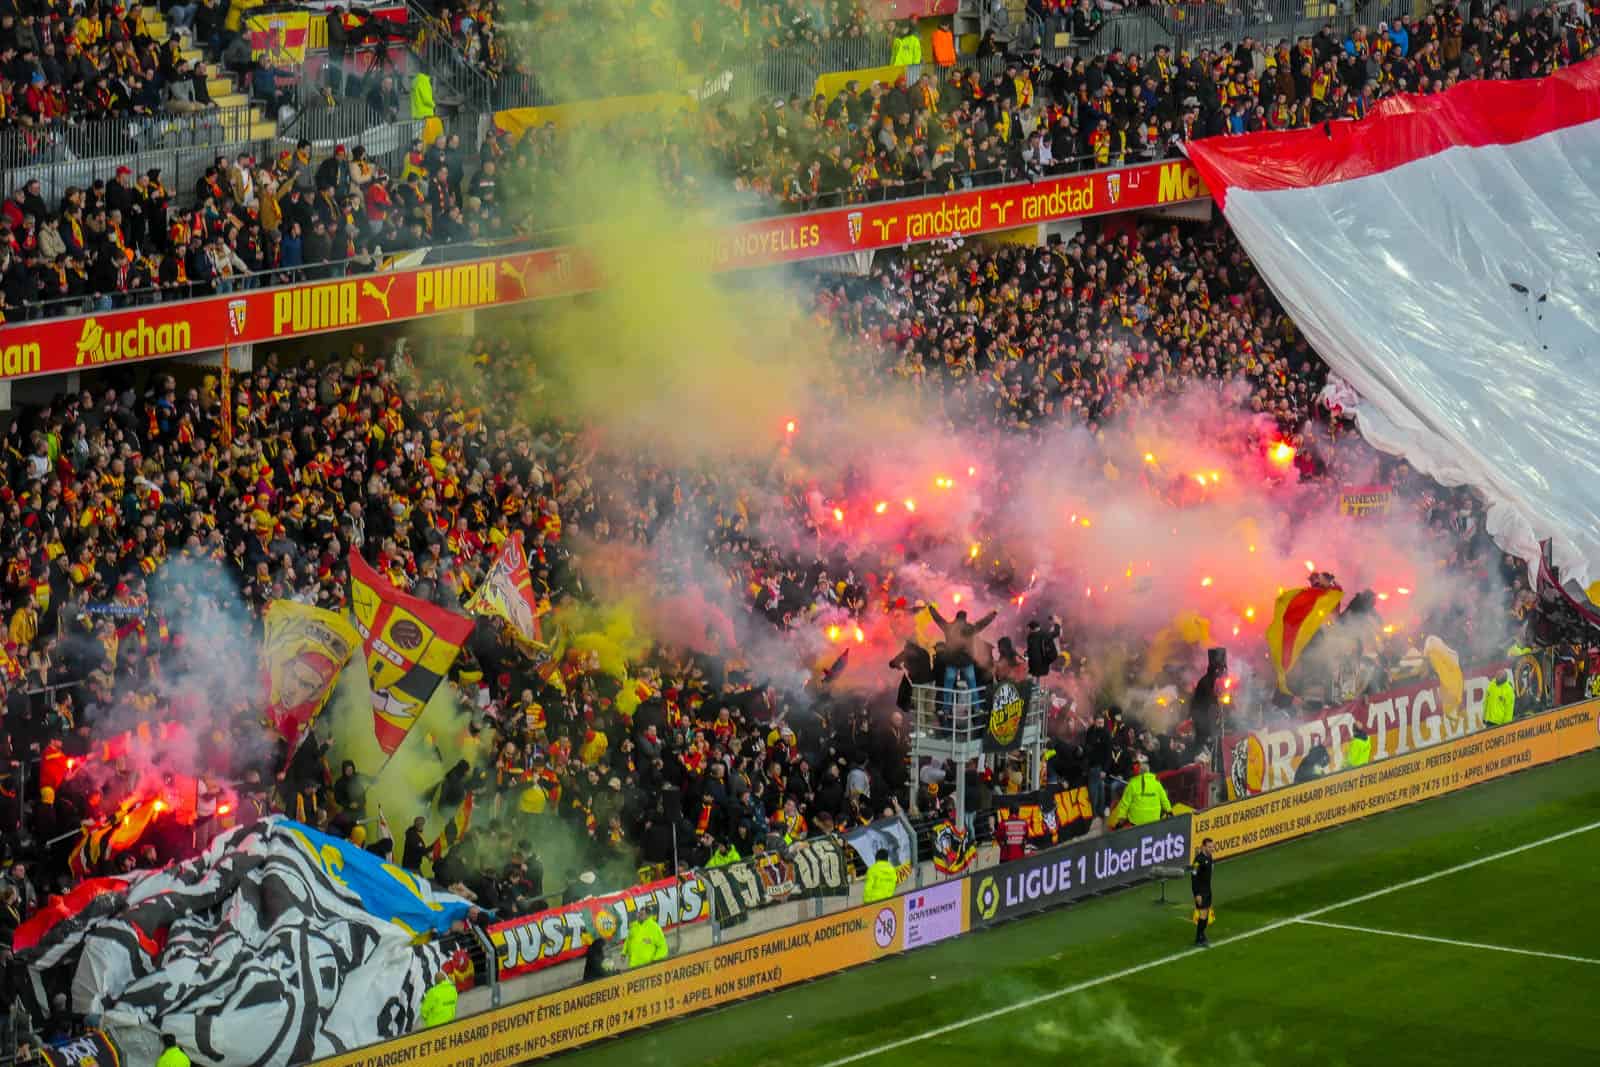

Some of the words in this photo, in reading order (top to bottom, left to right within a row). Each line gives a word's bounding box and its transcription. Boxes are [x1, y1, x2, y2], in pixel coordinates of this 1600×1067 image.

[906, 196, 983, 238] randstad
[1022, 177, 1095, 220] randstad
[733, 223, 820, 258] NOYELLES
[273, 281, 359, 335] PUMA
[415, 262, 497, 313] PUMA
[0, 341, 41, 375] an
[75, 317, 191, 366] Auchan
[1195, 818, 1210, 834] LES
[1211, 813, 1231, 829] JEUX
[1233, 805, 1271, 825] D'ARGENT
[1271, 802, 1281, 814] ET
[1282, 798, 1292, 810] DE
[1292, 790, 1323, 807] HASARD
[1325, 780, 1358, 798] PEUVENT
[1379, 760, 1421, 785] DANGEREUX
[1425, 753, 1451, 770] PERTES
[1242, 830, 1258, 845] NOS
[1259, 820, 1295, 840] CONSEILS
[1297, 815, 1311, 829] SUR
[1464, 765, 1484, 780] APPEL
[1485, 760, 1500, 775] NON
[709, 862, 761, 916] 19
[795, 839, 841, 889] 06
[1006, 859, 1072, 906] LIGUE
[1077, 855, 1086, 885] 1
[1095, 847, 1138, 879] Uber
[1141, 833, 1185, 867] Eats
[908, 901, 957, 921] GOUVERNEMENT
[503, 911, 588, 969] JUST
[367, 1044, 417, 1067] D'ARGENT
[420, 1040, 433, 1057] ET
[434, 1036, 447, 1052] DE
[449, 1024, 489, 1048] HASARD
[491, 1010, 535, 1038] PEUVENT
[537, 1003, 561, 1021] ÊTRE
[564, 985, 620, 1017] DANGEREUX
[627, 973, 662, 996] PERTES
[714, 948, 759, 971] CONFLITS
[761, 934, 813, 957] FAMILIAUX,
[478, 1016, 604, 1066] JOUEURS-INFO-SERVICE.FR
[623, 1009, 635, 1023] 74
[636, 1005, 648, 1019] 75
[650, 1002, 661, 1016] 13
[664, 997, 674, 1011] 13
[682, 986, 713, 1004] APPEL
[714, 980, 736, 996] NON
[737, 965, 783, 991] SURTAXÉ)
